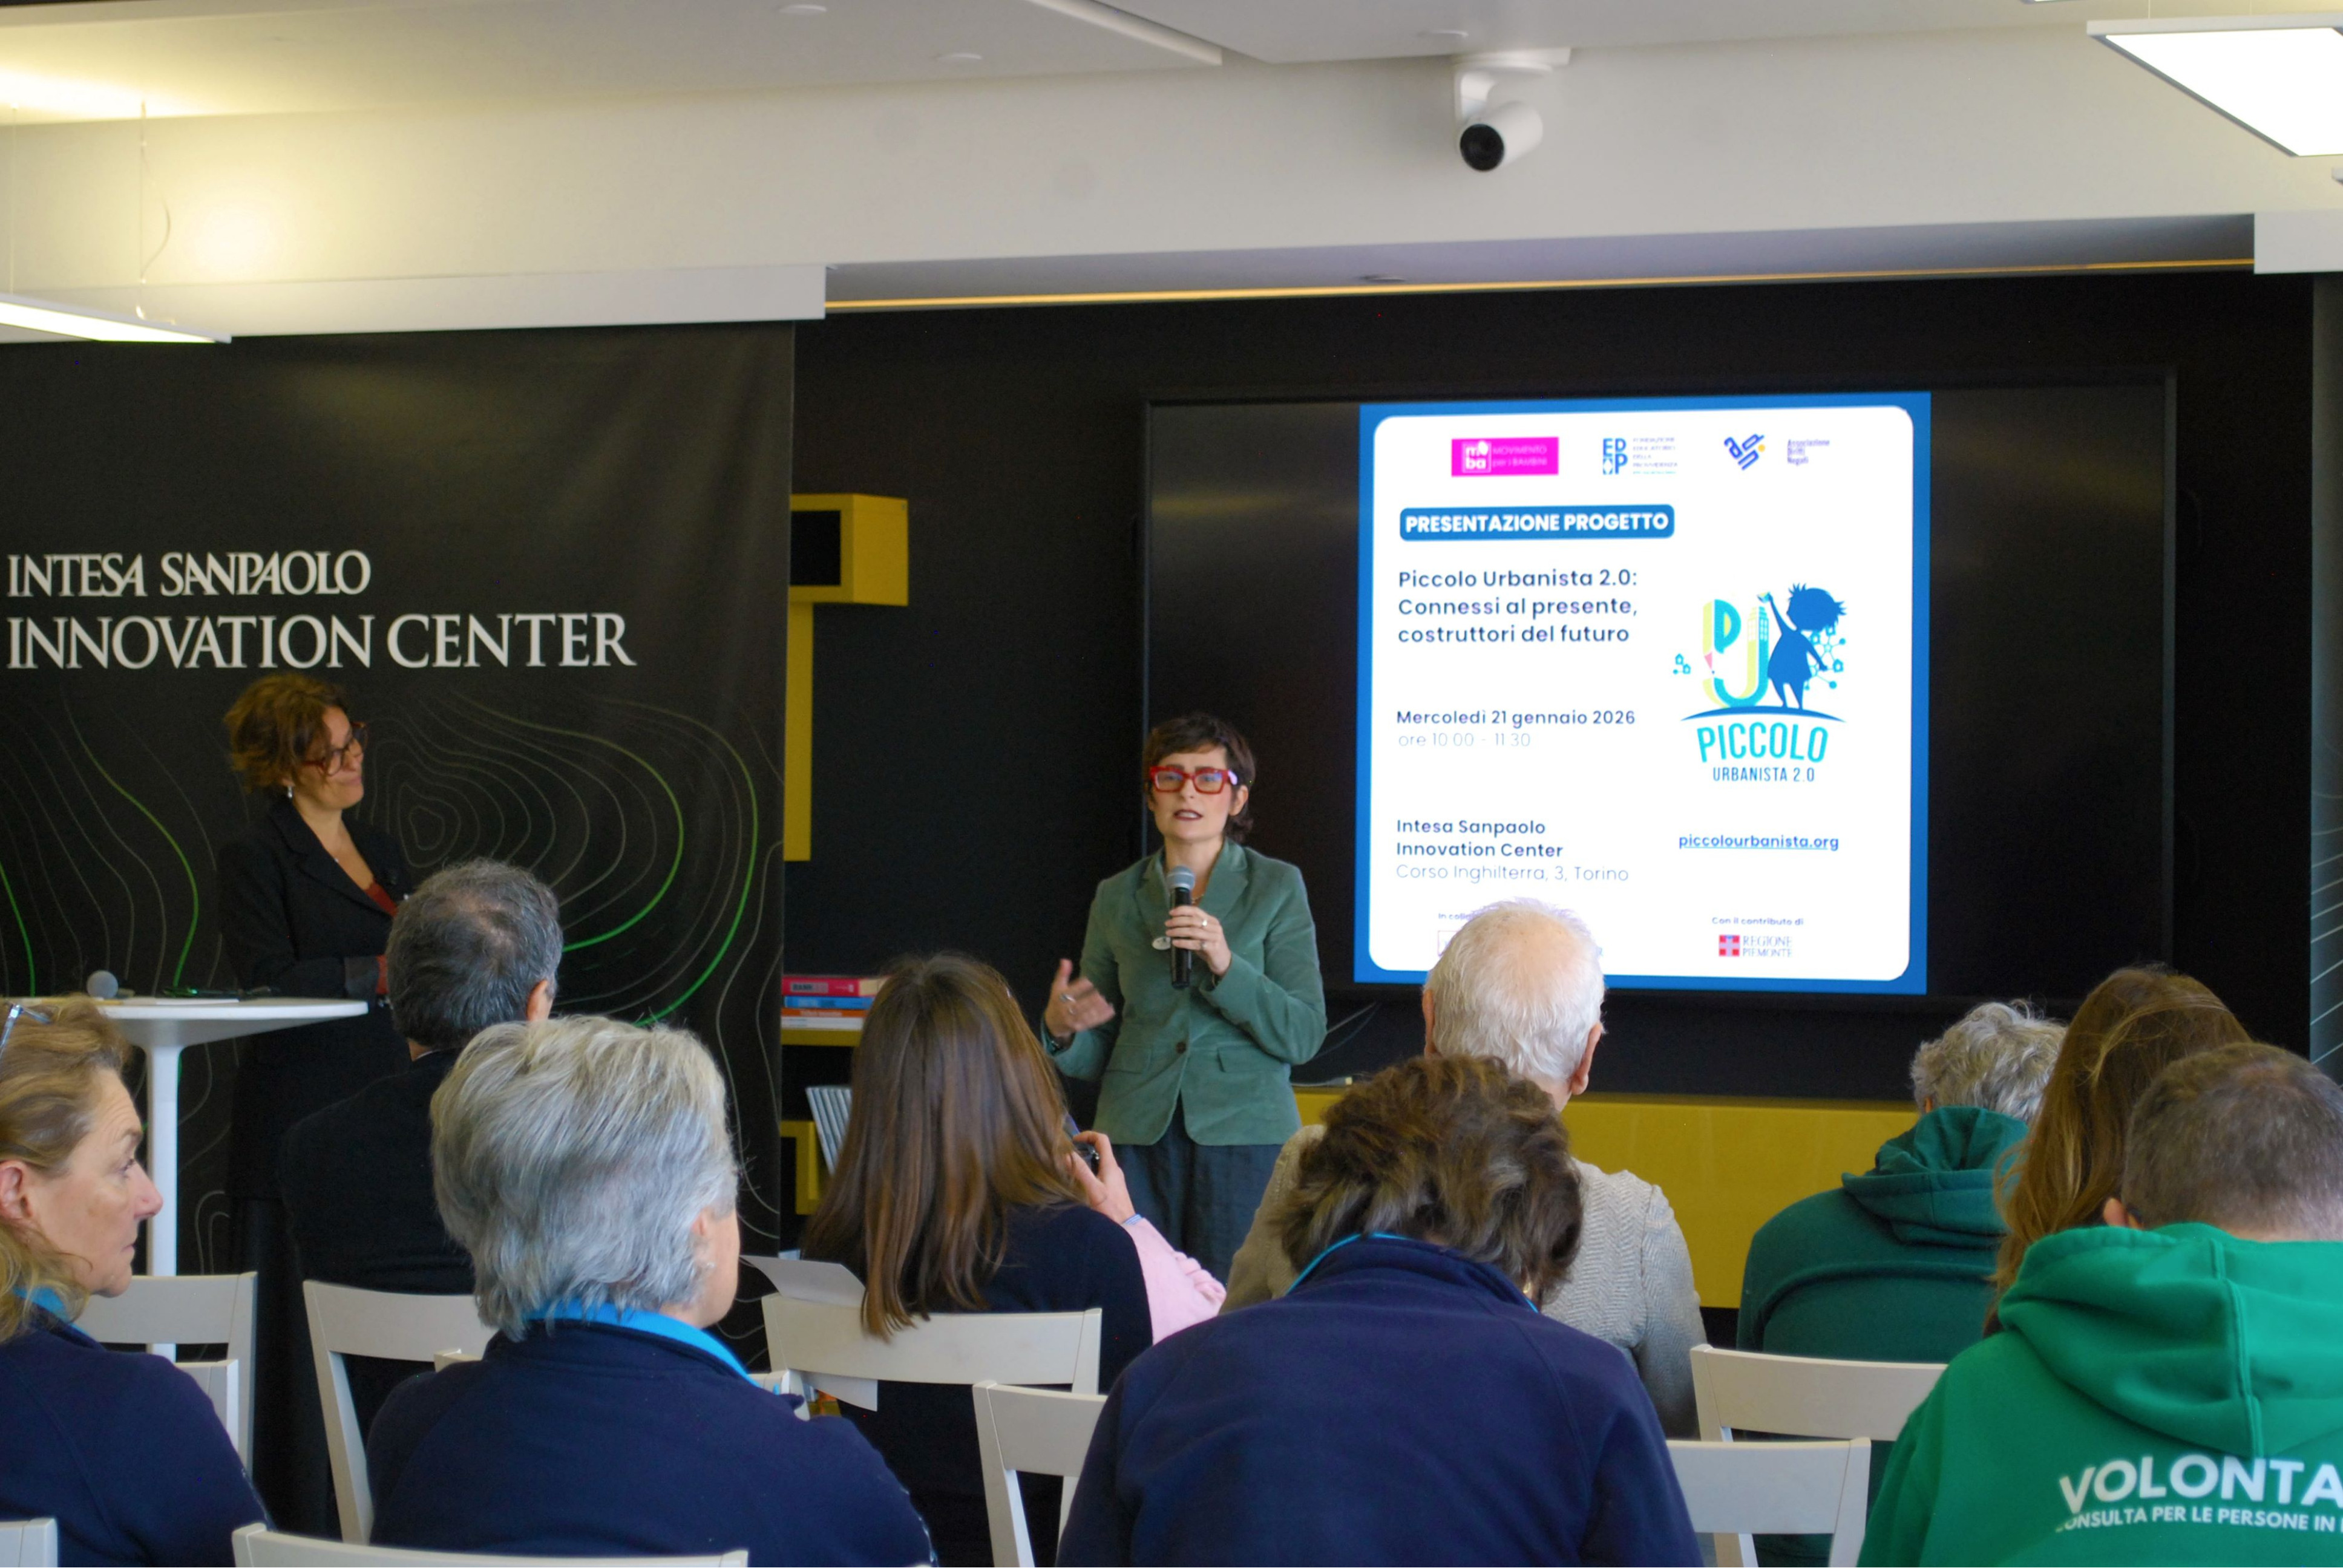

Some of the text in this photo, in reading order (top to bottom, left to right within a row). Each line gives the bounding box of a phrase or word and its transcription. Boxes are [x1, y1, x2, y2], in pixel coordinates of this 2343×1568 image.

[1405, 512, 1669, 533] PRESENTAZIONE PROGETTO
[7, 549, 372, 598] INTESA SANPAOLO
[1399, 568, 1637, 588] Piccolo Urbanista 2.0:
[1398, 596, 1637, 619] Connessi al presente,
[7, 612, 637, 670] INNOVATION CENTER
[1398, 624, 1630, 643] costruttori del futuro
[1397, 709, 1636, 730] Mercoledì 21 gennaio 2026
[1398, 735, 1427, 747] ore
[1697, 722, 1829, 763] PICCOLO
[1713, 766, 1815, 783] URBANISTA 2.0
[1397, 819, 1546, 838] Intesa Sanpaolo
[1397, 841, 1564, 858] Innovation Center
[1679, 834, 1840, 852] piccolourbanista.org
[1396, 864, 1629, 885] Corso Inghilterra, 3, Torino
[1740, 917, 1793, 926] contributo
[1795, 918, 1804, 926] di
[2059, 1454, 2343, 1514] VOLONTA
[2055, 1508, 2148, 1533] ONSULTA
[2152, 1506, 2186, 1523] PER
[2192, 1507, 2212, 1523] LE
[2217, 1509, 2309, 1530] PERSONE
[2314, 1515, 2336, 1532] IN
